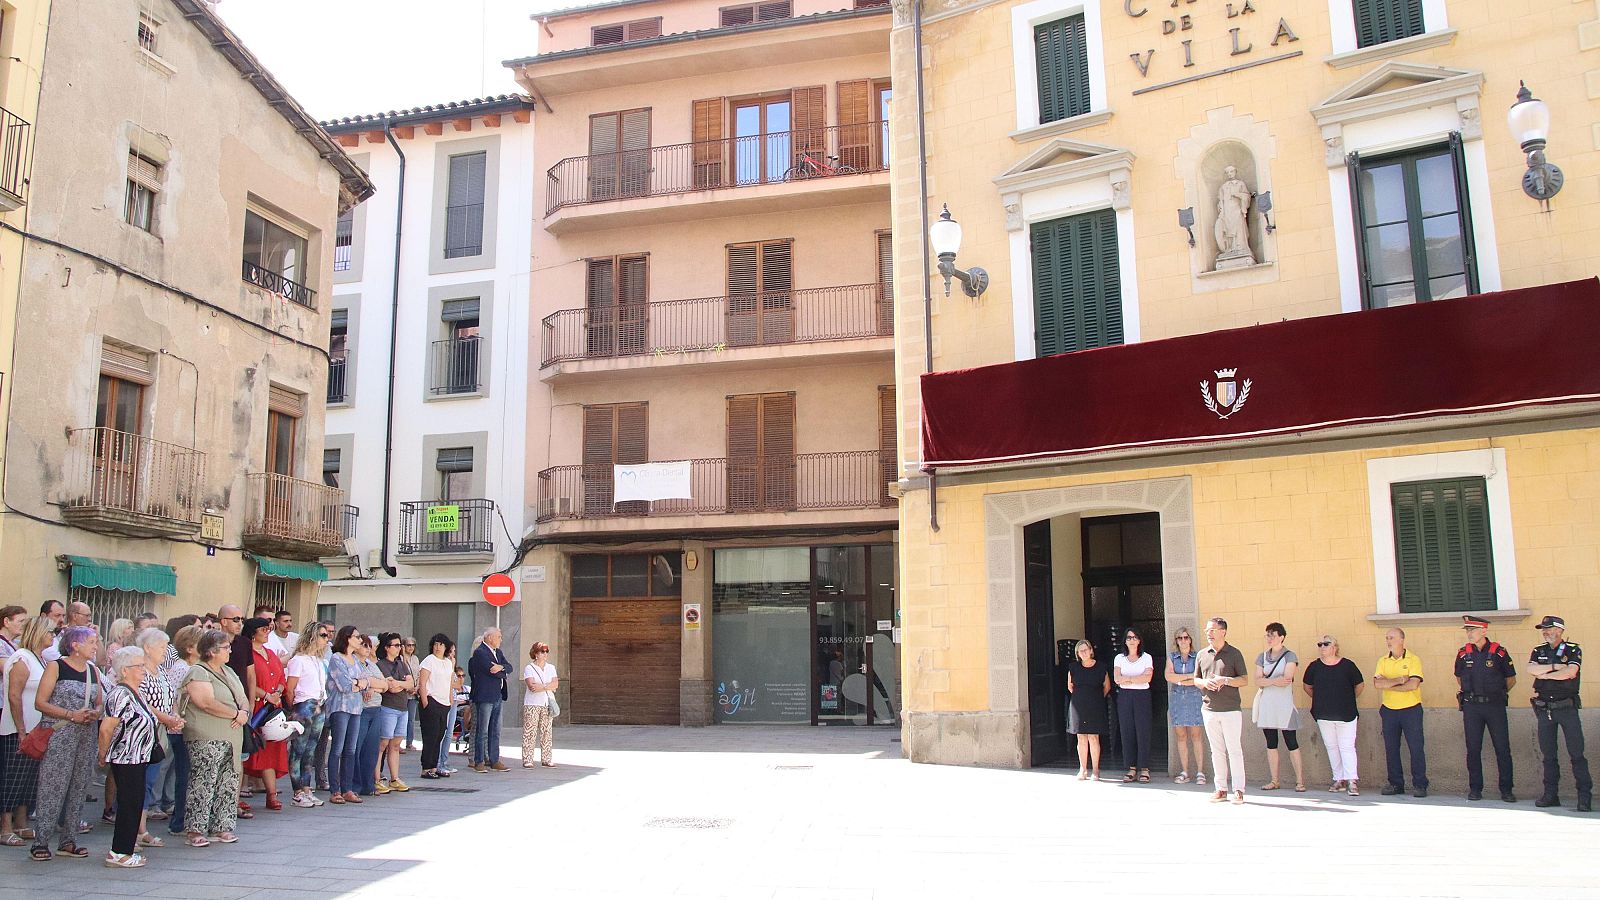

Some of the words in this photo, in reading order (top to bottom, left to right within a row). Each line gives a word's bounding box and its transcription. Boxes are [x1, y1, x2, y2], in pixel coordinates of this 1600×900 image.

[1162, 14, 1194, 35] DE
[1226, 0, 1256, 19] LA
[1130, 17, 1299, 78] VILA
[429, 515, 455, 523] VENDA
[206, 528, 220, 537] VILA
